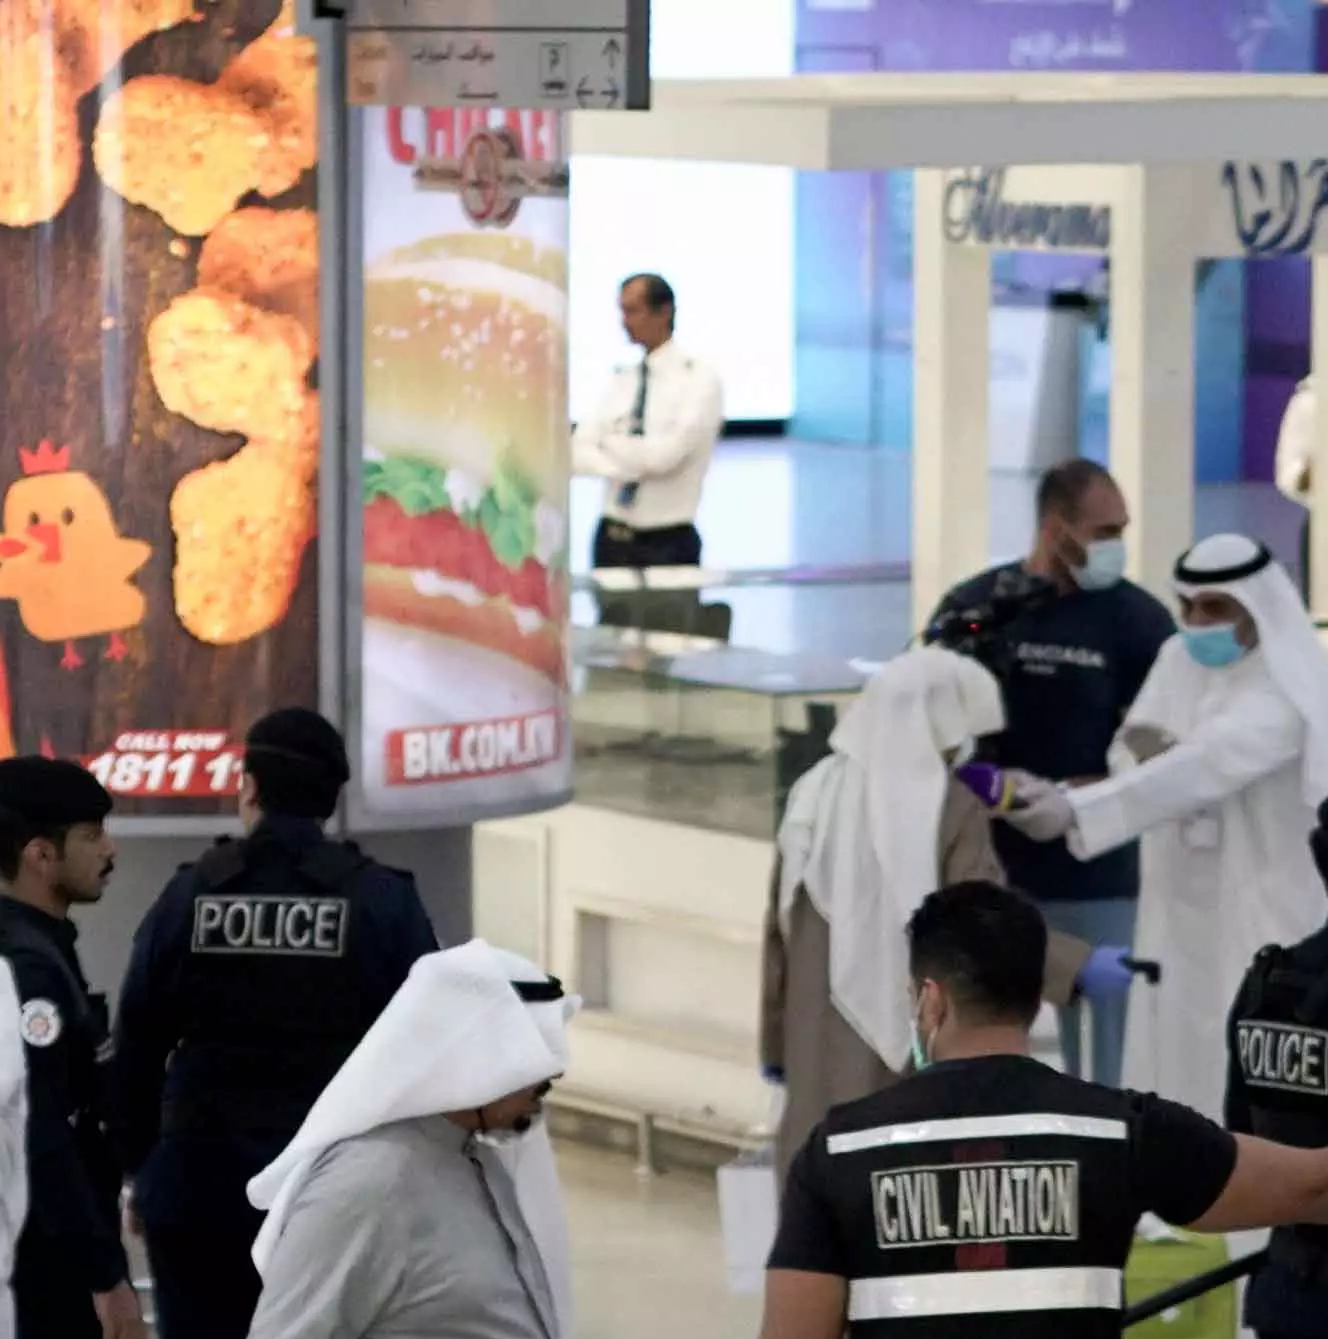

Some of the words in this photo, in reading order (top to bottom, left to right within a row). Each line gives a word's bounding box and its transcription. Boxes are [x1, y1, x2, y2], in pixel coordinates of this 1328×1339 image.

[115, 732, 170, 751] CALL
[174, 732, 226, 751] NOW
[87, 752, 197, 792] 1811
[198, 902, 338, 949] POLICE
[1238, 1028, 1321, 1087] POLICE
[879, 1172, 951, 1242] CIVIL
[956, 1165, 1074, 1238] AVIATION
